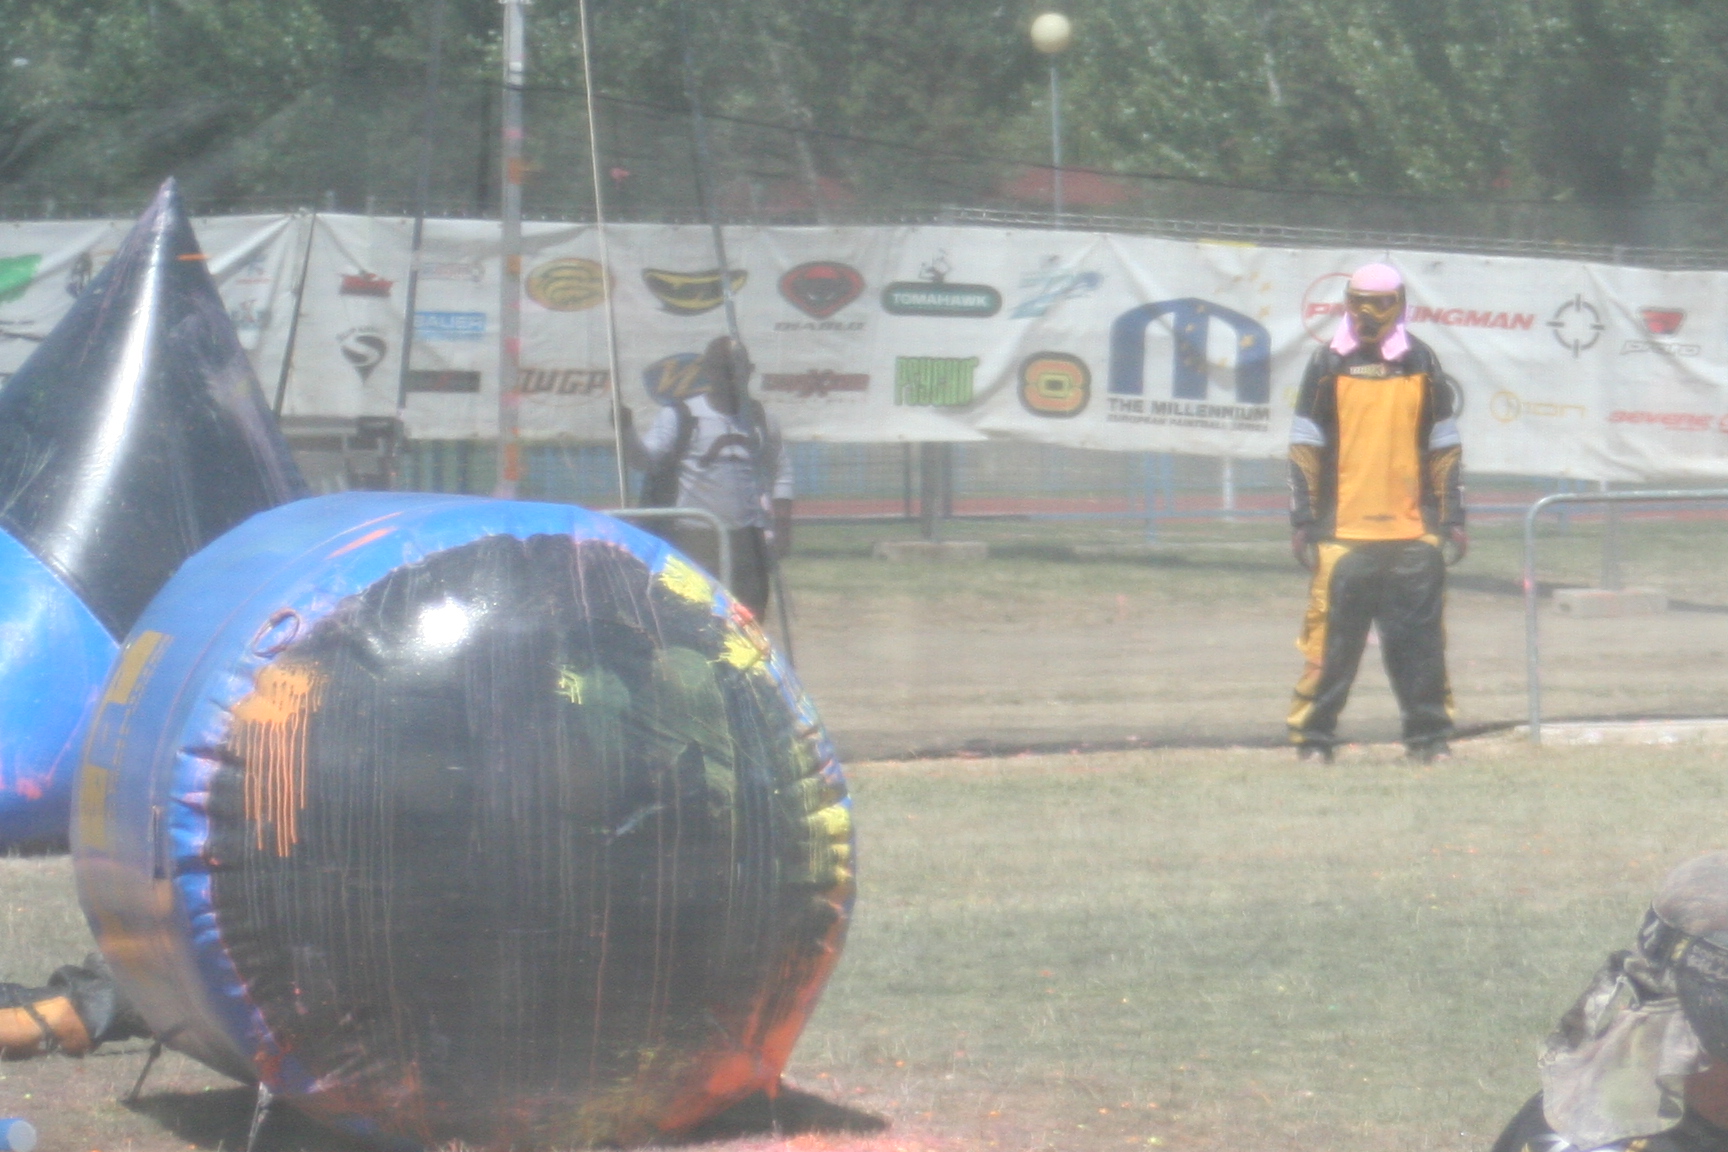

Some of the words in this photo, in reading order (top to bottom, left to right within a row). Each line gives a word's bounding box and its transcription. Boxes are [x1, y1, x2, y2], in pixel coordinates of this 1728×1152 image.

[893, 292, 988, 306] TOMAHAWK
[1107, 397, 1143, 413] THE
[1151, 400, 1269, 421] MILLENNIUM
